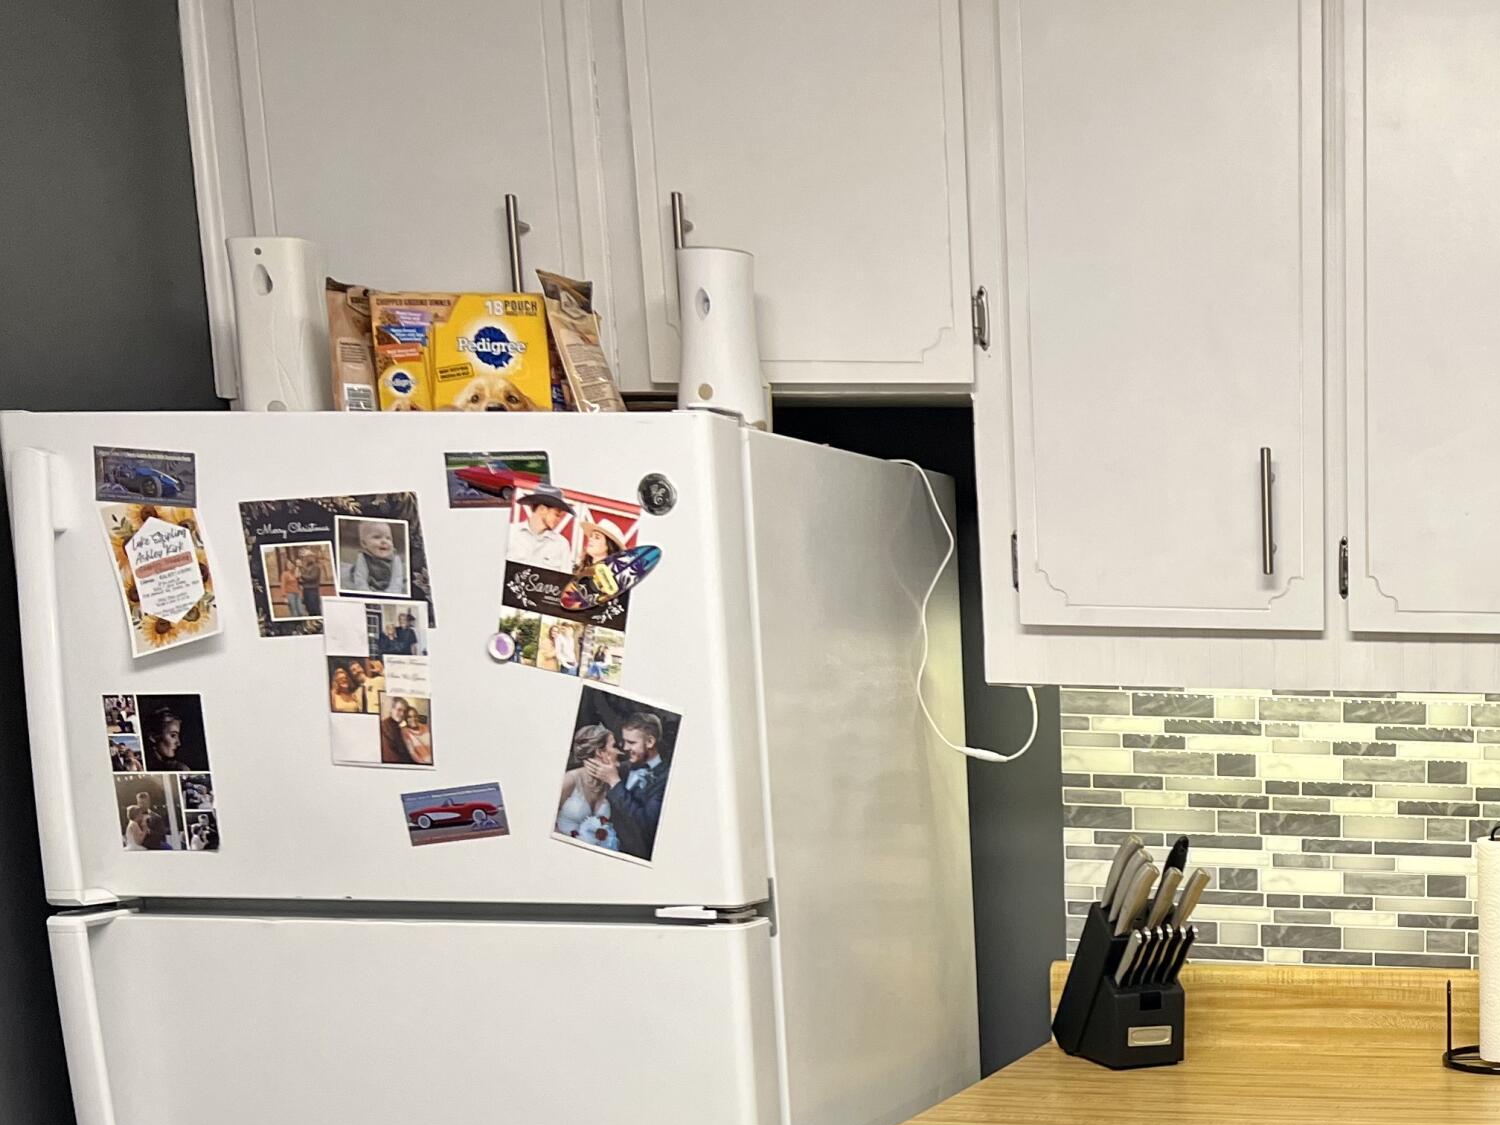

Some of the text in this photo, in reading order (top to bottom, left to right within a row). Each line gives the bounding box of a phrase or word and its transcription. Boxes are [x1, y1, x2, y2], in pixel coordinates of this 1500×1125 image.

[485, 300, 538, 315] 18 POUCH
[457, 337, 527, 355] Pedigree
[257, 522, 330, 539] Merry Christmas
[525, 573, 561, 596] Save
